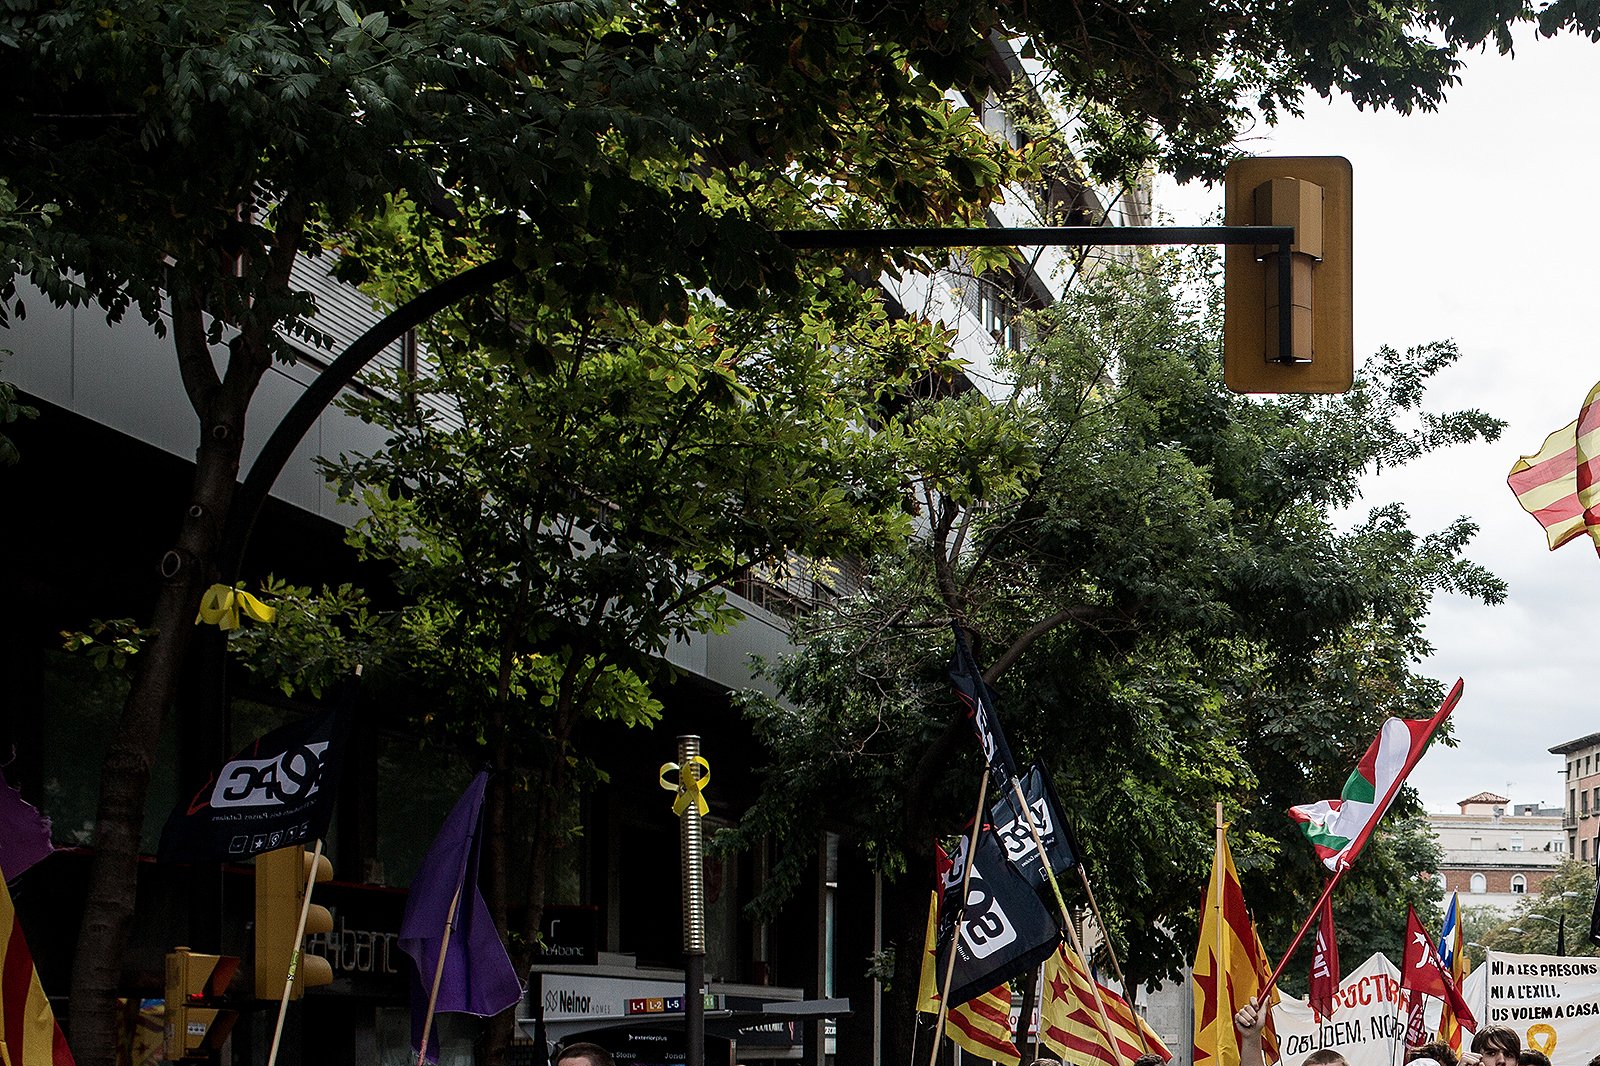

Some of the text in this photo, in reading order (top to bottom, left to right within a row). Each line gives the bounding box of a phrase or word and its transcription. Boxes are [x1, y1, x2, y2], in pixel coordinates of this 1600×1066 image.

[1491, 961, 1598, 978] NI A LES PRESONS
[1491, 984, 1561, 999] NI A L'EXILI,
[560, 990, 591, 1013] Neinor
[632, 1002, 644, 1011] L-1
[649, 1000, 662, 1010] L-2
[666, 999, 680, 1009] L-5
[1492, 1002, 1600, 1022] US VOLEM A CASA
